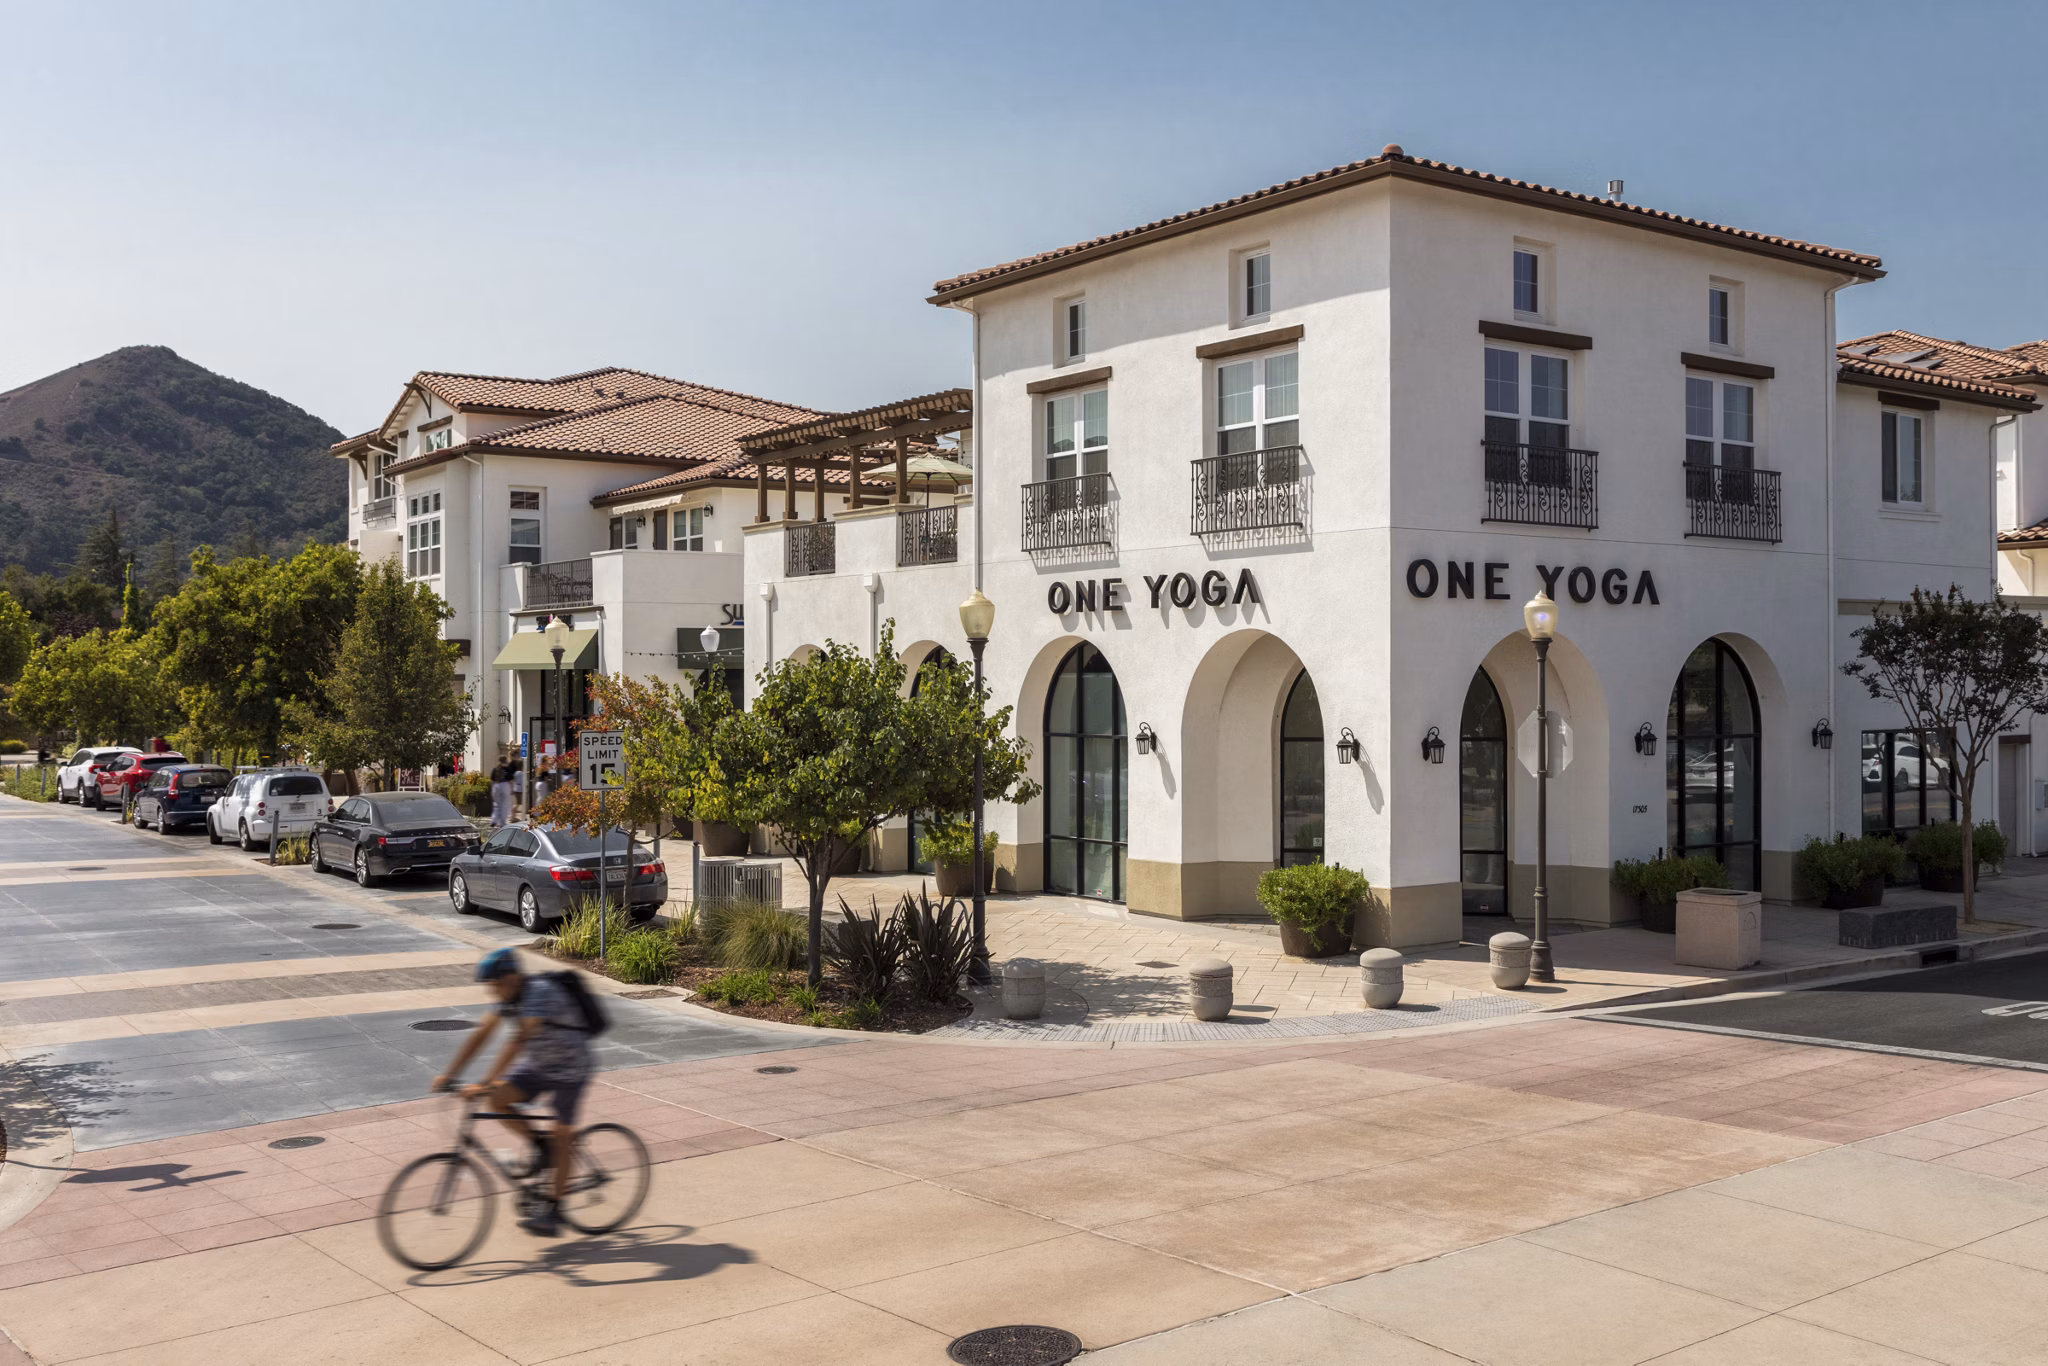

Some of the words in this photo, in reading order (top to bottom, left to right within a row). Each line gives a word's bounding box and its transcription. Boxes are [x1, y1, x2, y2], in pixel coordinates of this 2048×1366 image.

[1047, 577, 1123, 615] ONE
[1143, 567, 1261, 609] YOGA
[1406, 558, 1511, 600] ONE
[1536, 564, 1660, 605] YOGA
[583, 736, 623, 746] SPEED
[587, 749, 619, 760] LIMIT
